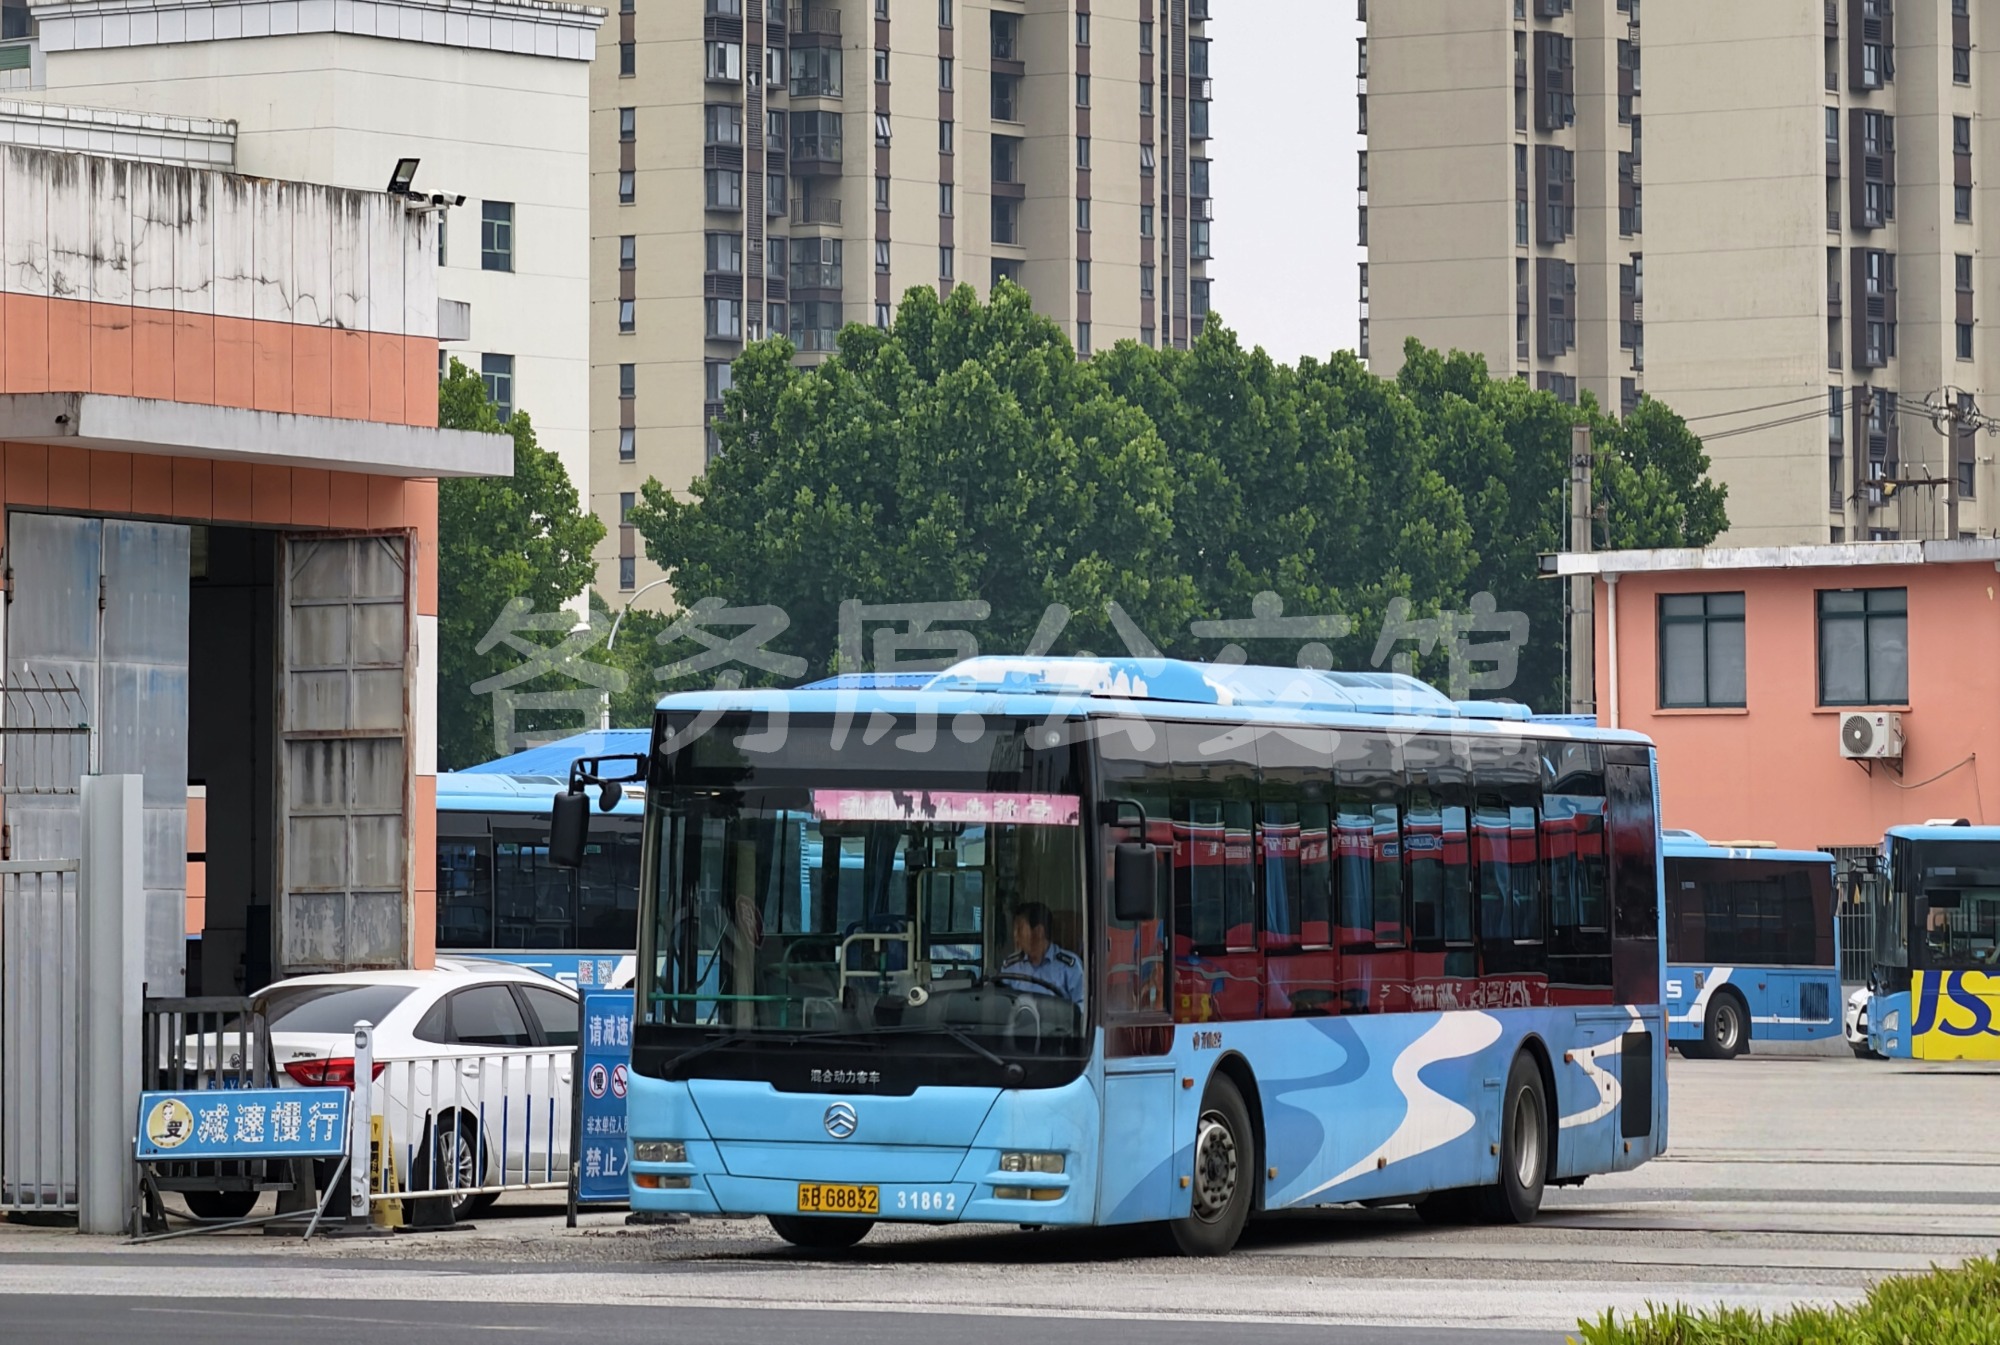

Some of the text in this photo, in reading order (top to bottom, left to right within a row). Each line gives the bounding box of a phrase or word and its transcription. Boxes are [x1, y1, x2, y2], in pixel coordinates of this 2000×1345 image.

[589, 1014, 634, 1047] 请减速
[810, 1069, 881, 1085] 混合动力客车
[197, 1102, 339, 1144] 减速慢行
[897, 1191, 955, 1211] 31862
